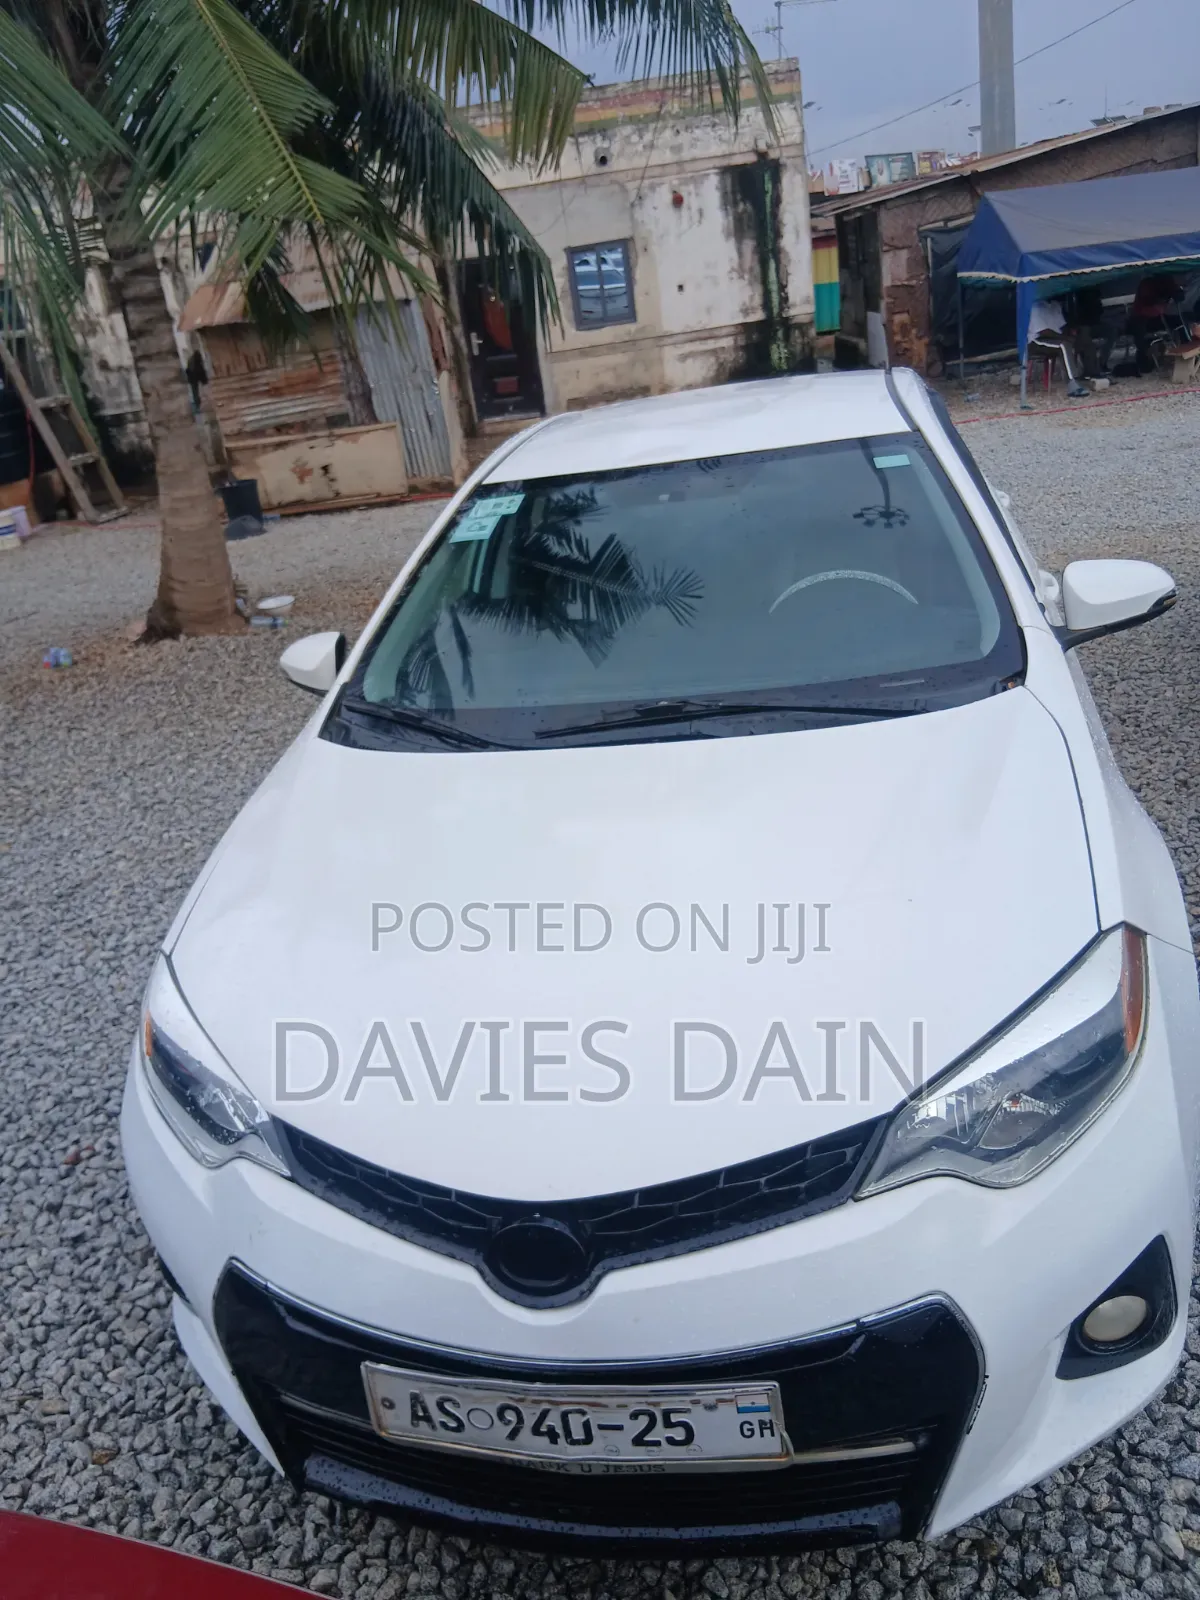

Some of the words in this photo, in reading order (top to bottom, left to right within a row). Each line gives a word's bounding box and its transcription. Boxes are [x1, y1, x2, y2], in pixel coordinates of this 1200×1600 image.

[410, 1389, 466, 1433] AS
[496, 1402, 695, 1447] 940-25
[739, 1418, 775, 1438] GH
[581, 1462, 593, 1474] U
[602, 1463, 666, 1474] JESUS
